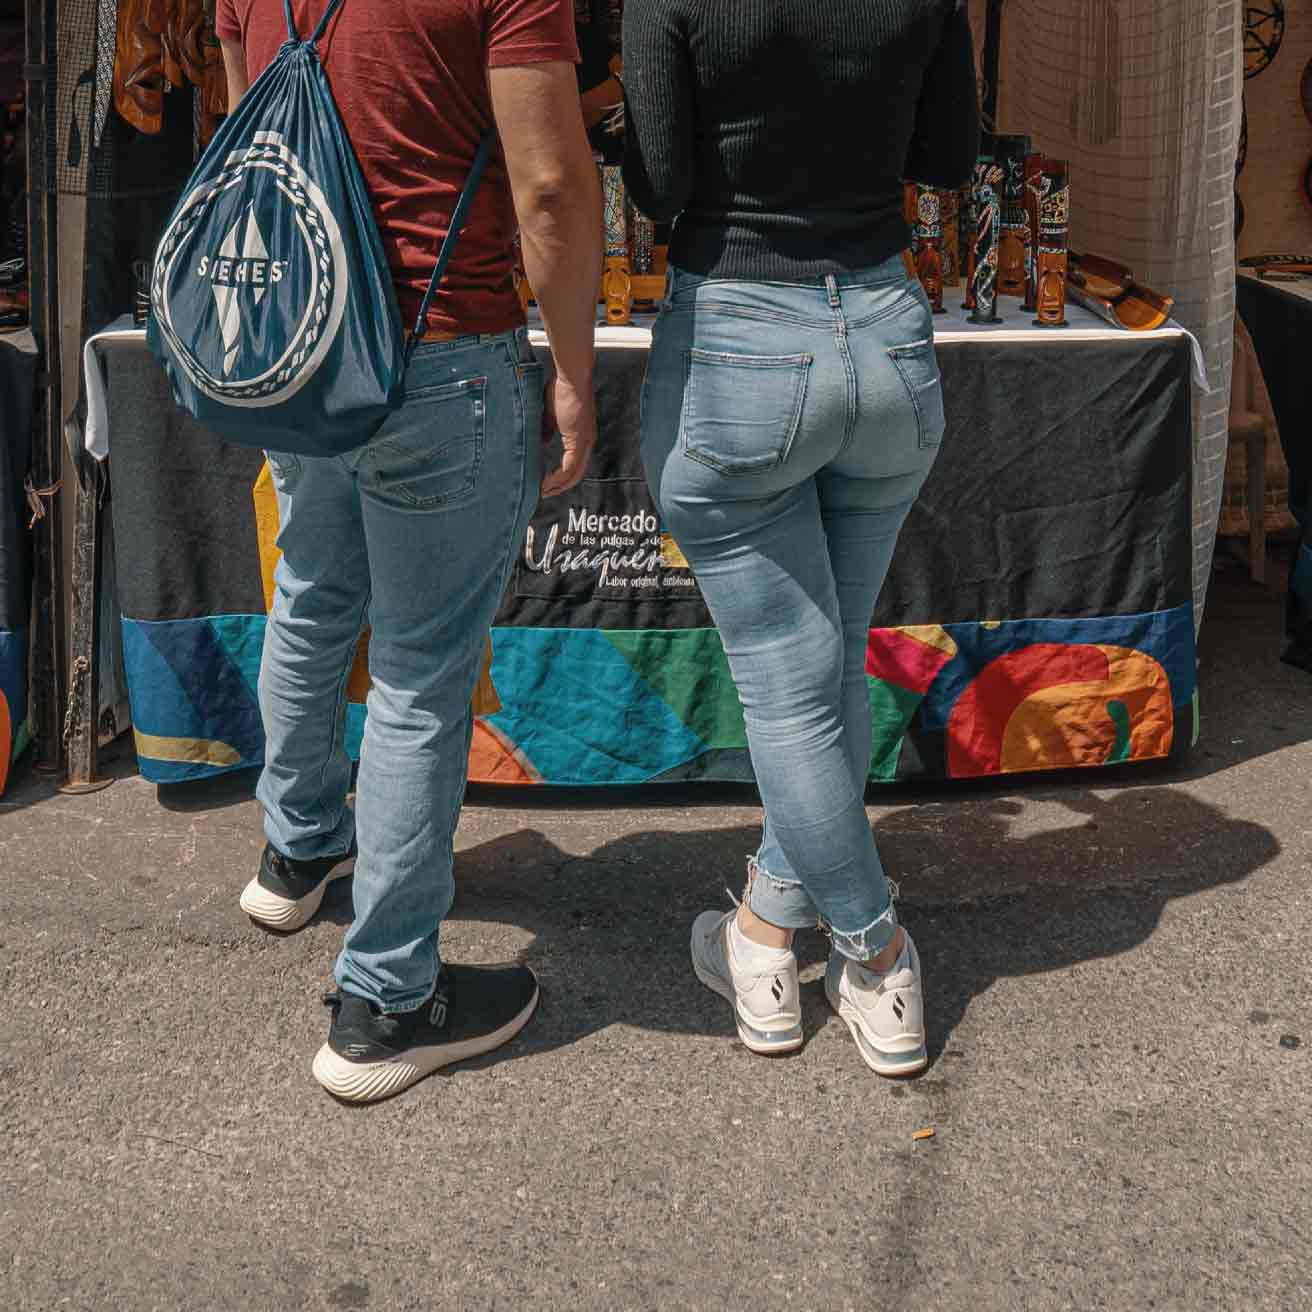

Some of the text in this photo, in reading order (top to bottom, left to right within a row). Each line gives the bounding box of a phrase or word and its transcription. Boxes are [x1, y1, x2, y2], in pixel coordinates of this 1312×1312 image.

[568, 508, 657, 533] Mercado
[561, 533, 576, 545] de
[580, 533, 596, 545] las
[600, 533, 634, 549] pulgas
